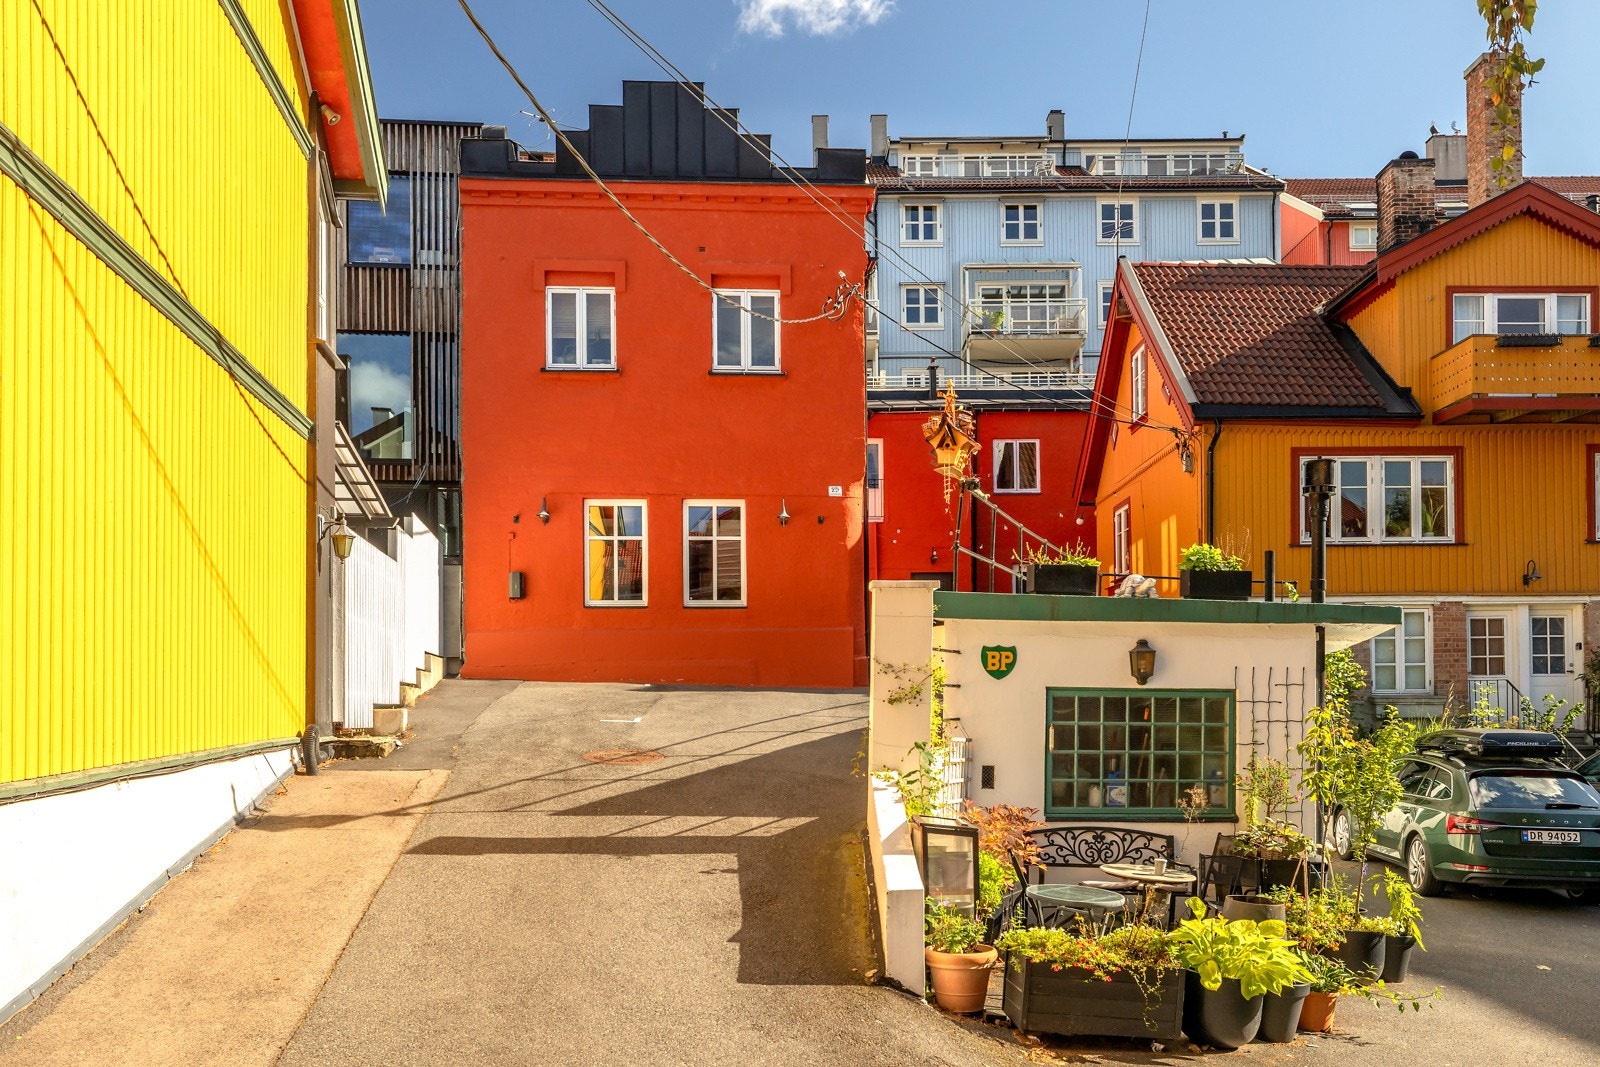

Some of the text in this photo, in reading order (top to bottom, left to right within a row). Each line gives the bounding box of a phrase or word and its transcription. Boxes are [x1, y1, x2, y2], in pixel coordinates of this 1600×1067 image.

[985, 651, 1014, 671] BP
[1529, 831, 1578, 842] DR 94052
